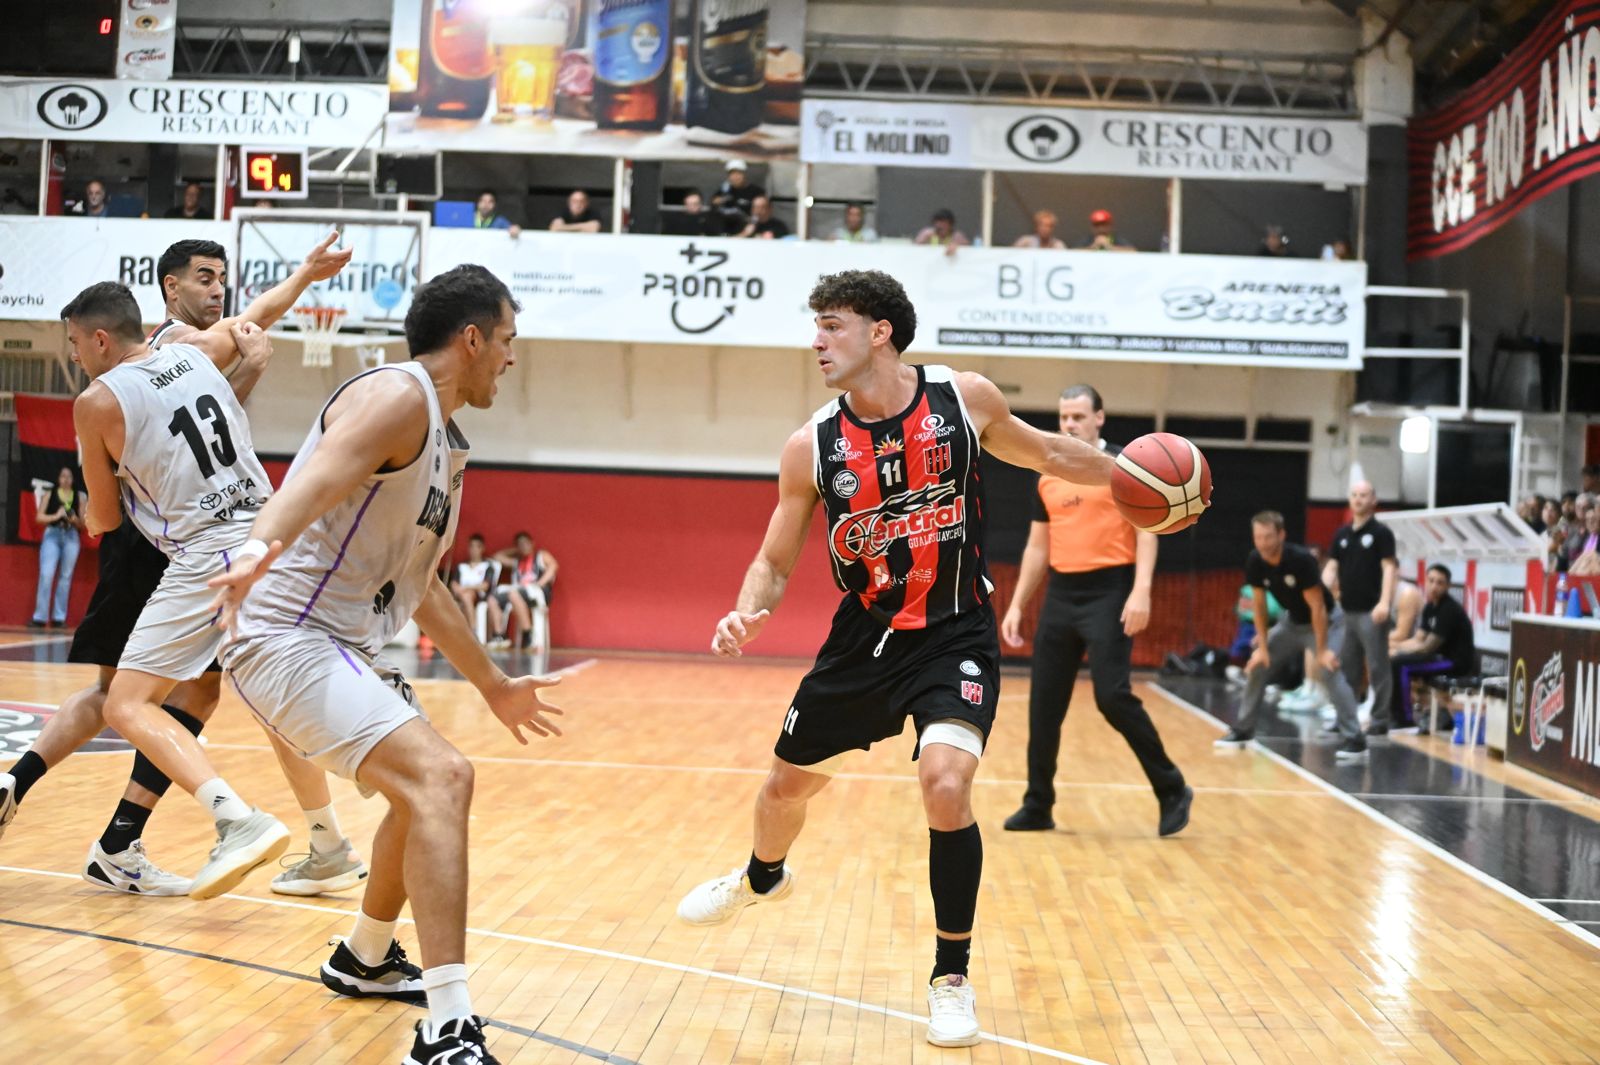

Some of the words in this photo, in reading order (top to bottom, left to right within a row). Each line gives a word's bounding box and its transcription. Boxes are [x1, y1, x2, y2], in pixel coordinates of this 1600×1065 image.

[129, 87, 348, 119] CRESCENCIO
[161, 116, 312, 136] RESTAURANT
[1102, 119, 1332, 156] CRESCENCIO
[834, 130, 855, 152] EL
[866, 132, 949, 155] MOLINO
[1482, 86, 1525, 206] 100
[251, 157, 273, 191] 9
[1138, 151, 1296, 173] RESTAURANT
[644, 274, 764, 300] PRONTO
[998, 264, 1023, 300] B
[1045, 265, 1075, 302] G
[1222, 281, 1342, 296] ARENERA
[958, 308, 1108, 327] CONTENEDORES
[150, 359, 194, 390] SANCHEZ
[167, 394, 238, 480] 13
[881, 459, 902, 487] 11
[220, 478, 257, 498] TOYTA
[784, 705, 799, 736] 11
